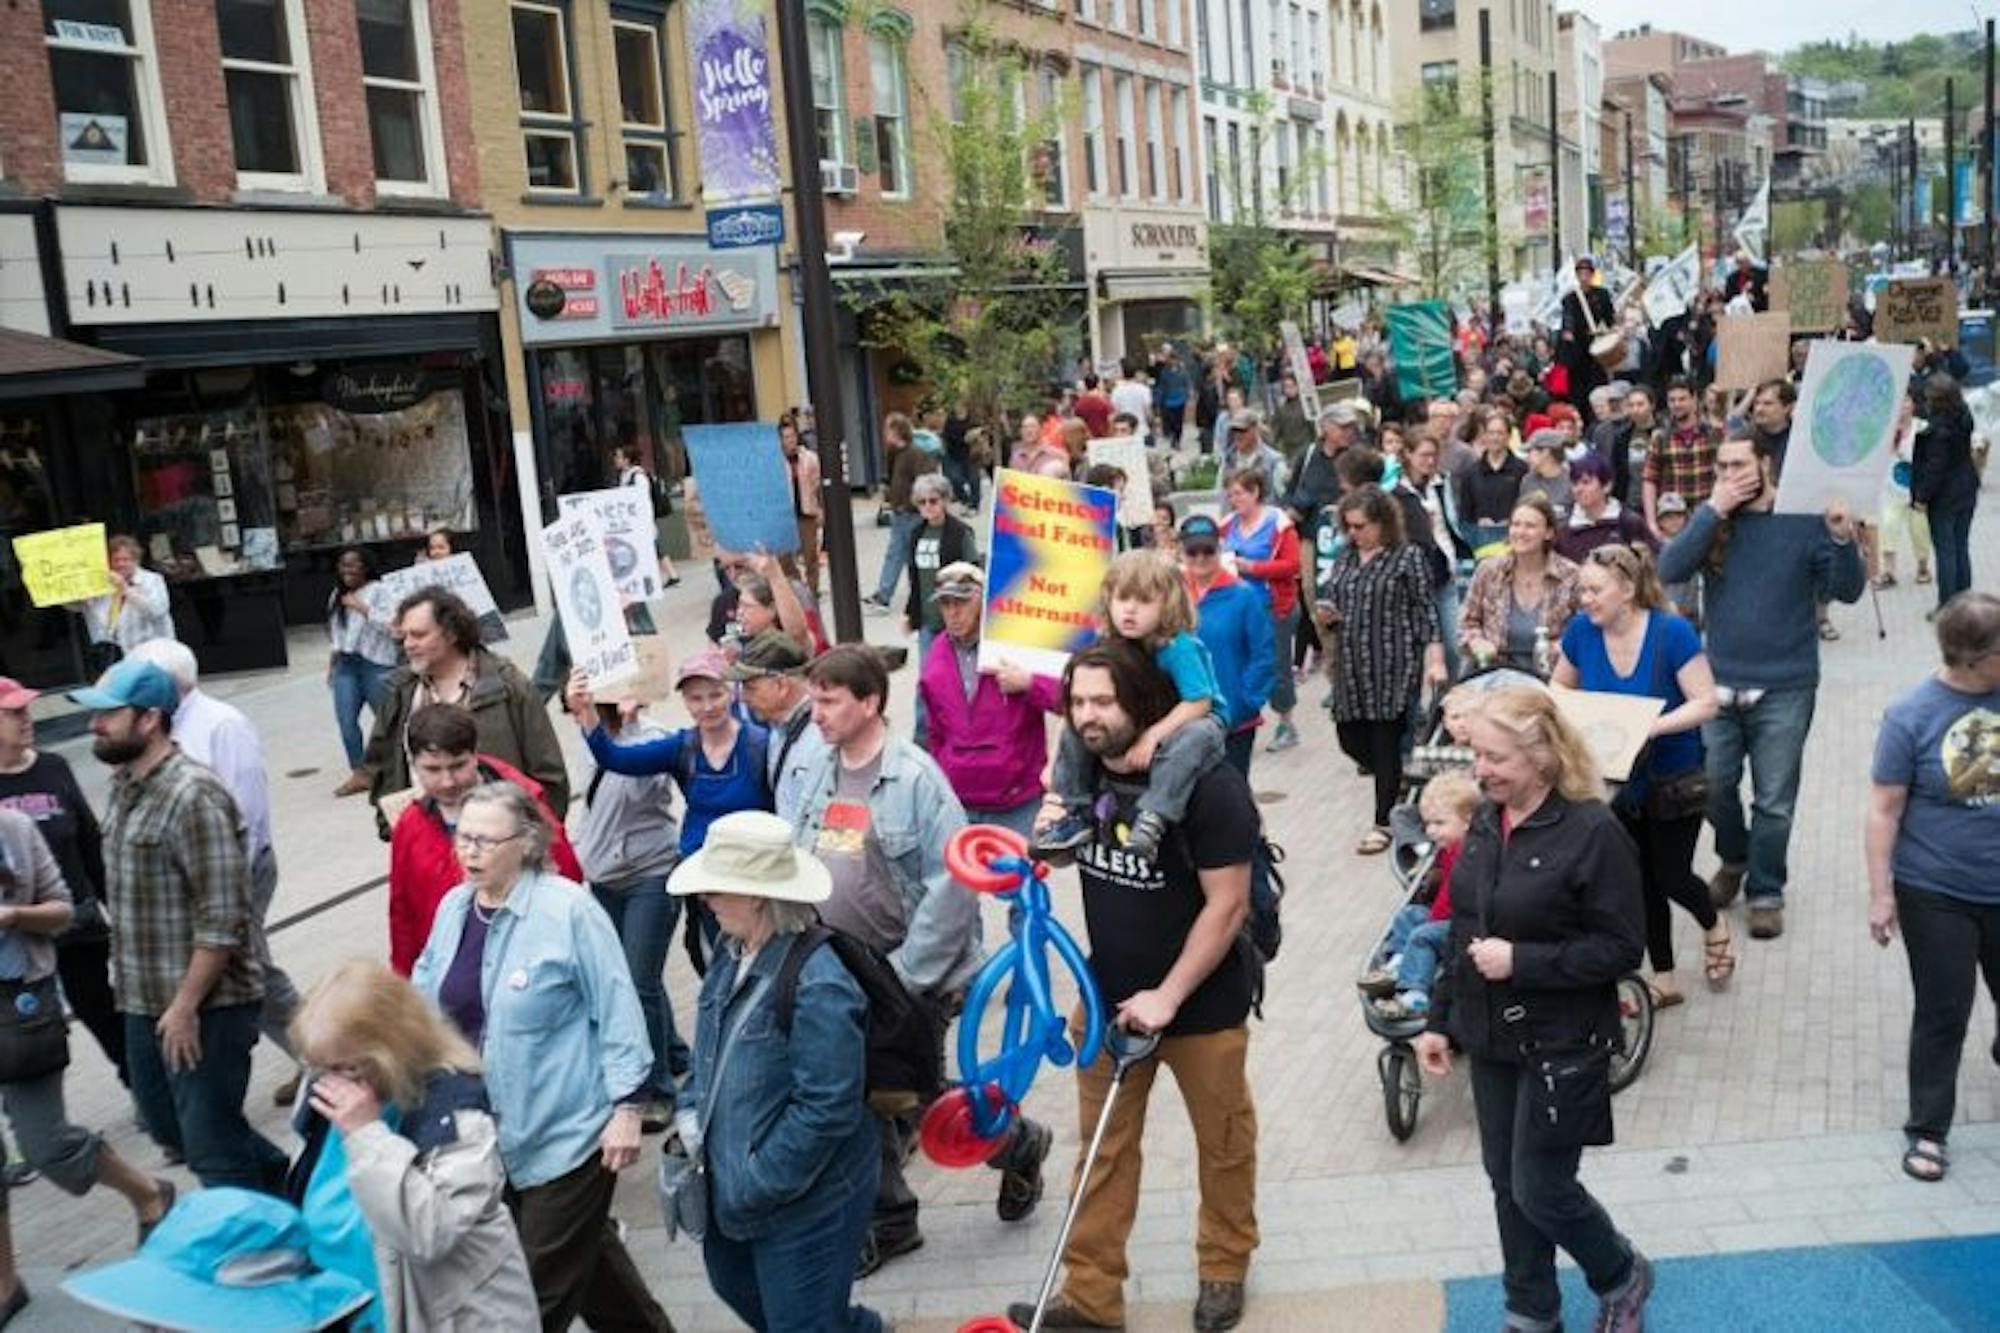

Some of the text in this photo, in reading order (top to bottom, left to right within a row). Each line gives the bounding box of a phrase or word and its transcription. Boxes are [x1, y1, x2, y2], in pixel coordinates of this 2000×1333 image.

[702, 46, 766, 95] Hello
[699, 84, 769, 123] Spring
[996, 513, 1113, 551] Real Facts
[1029, 575, 1068, 597] Not
